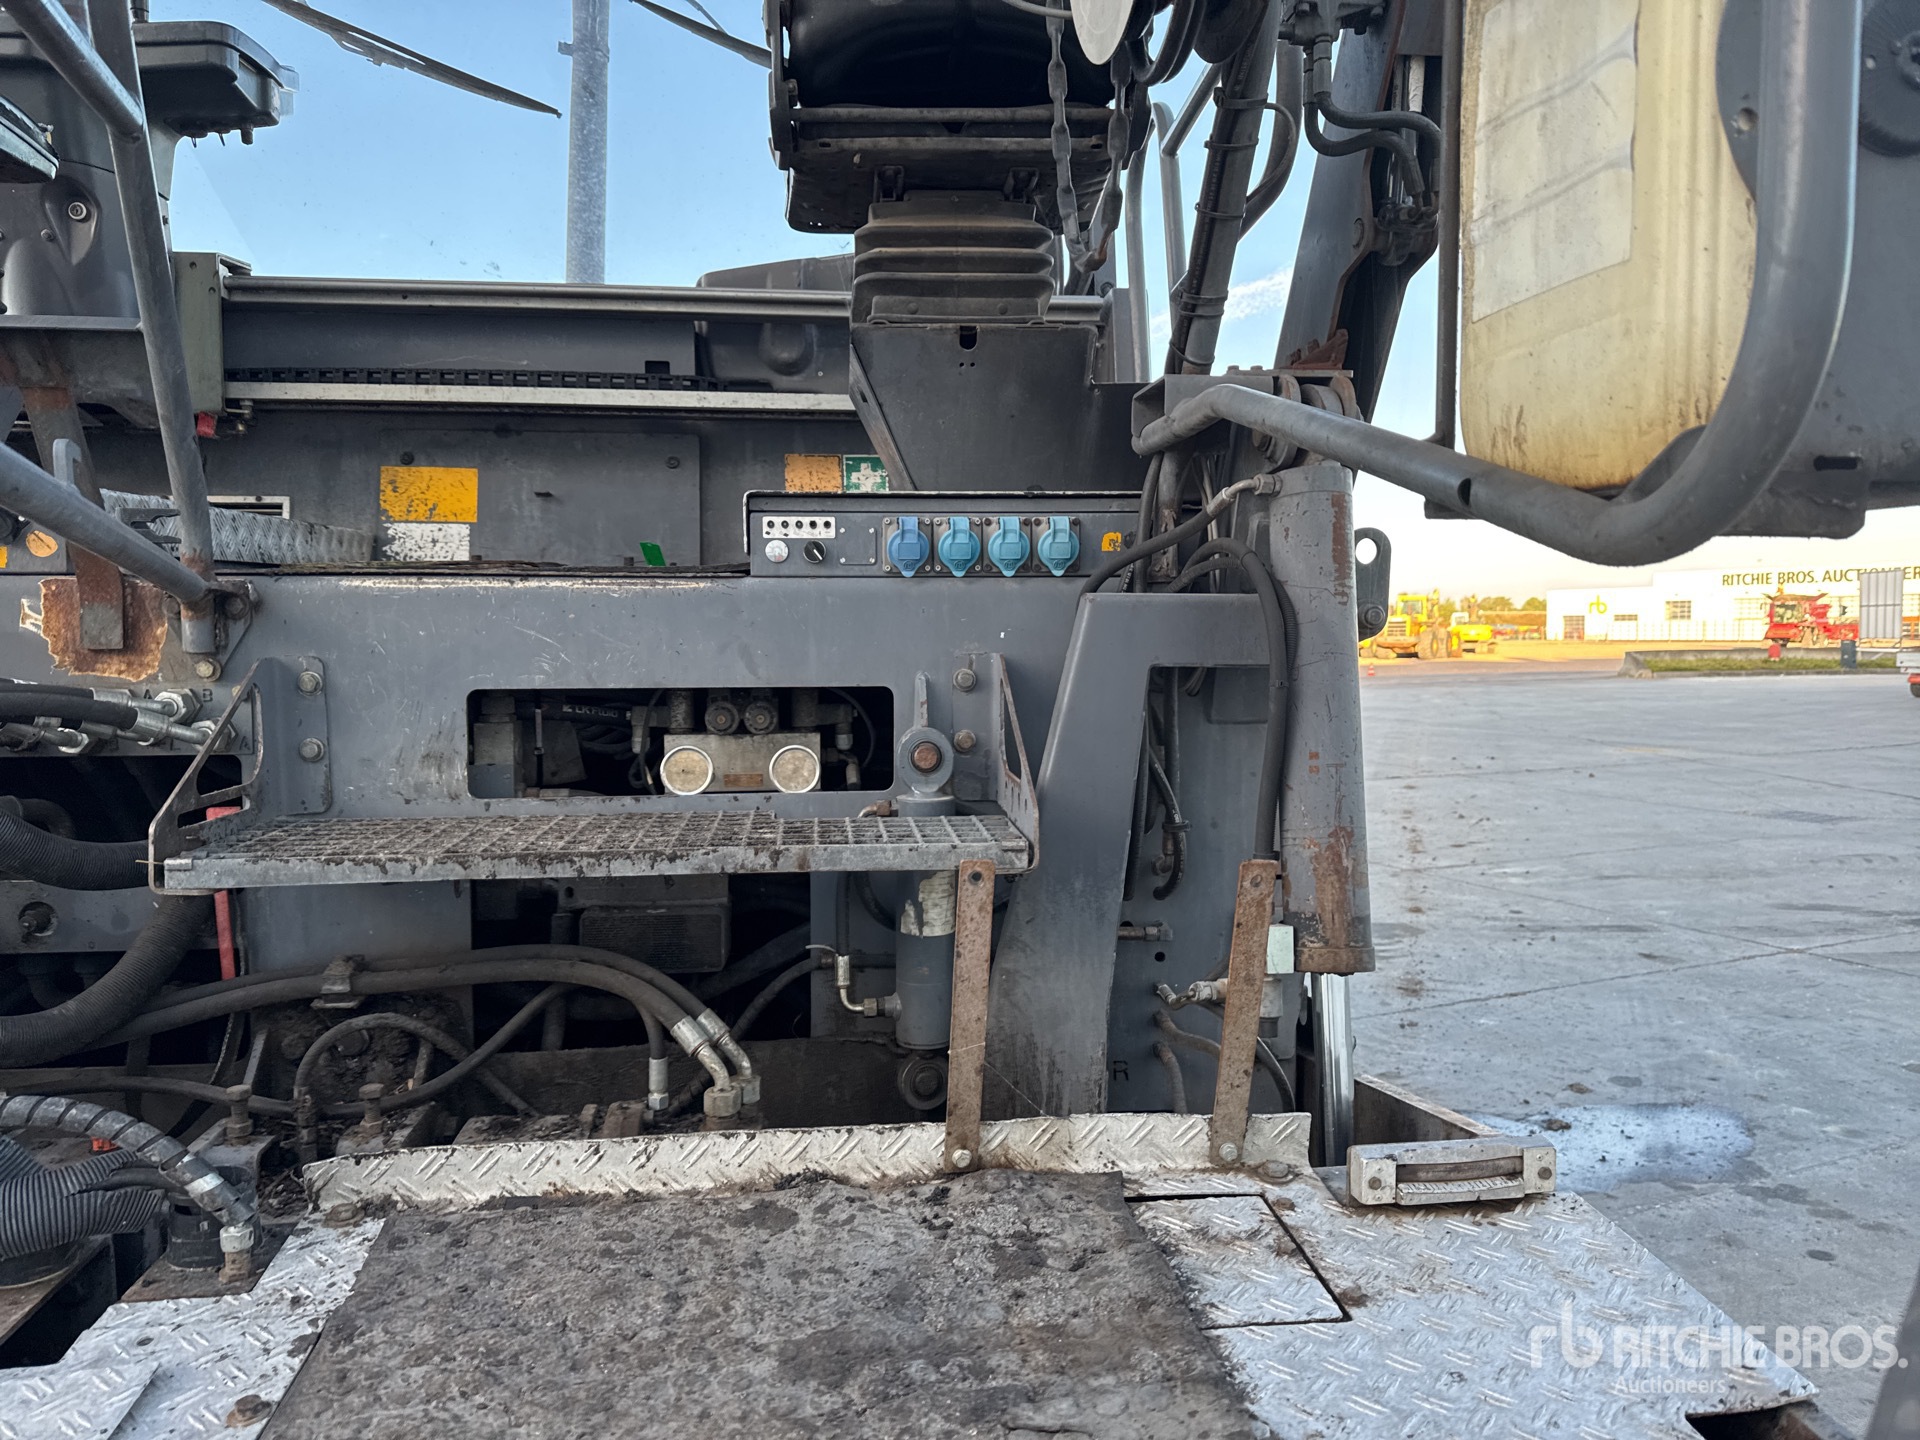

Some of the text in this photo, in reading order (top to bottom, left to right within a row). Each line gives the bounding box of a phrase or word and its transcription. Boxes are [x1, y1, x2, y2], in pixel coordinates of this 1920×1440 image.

[1722, 572, 1773, 586] RITCHIE
[1777, 570, 1819, 584] BROS.
[1113, 1060, 1129, 1081] R
